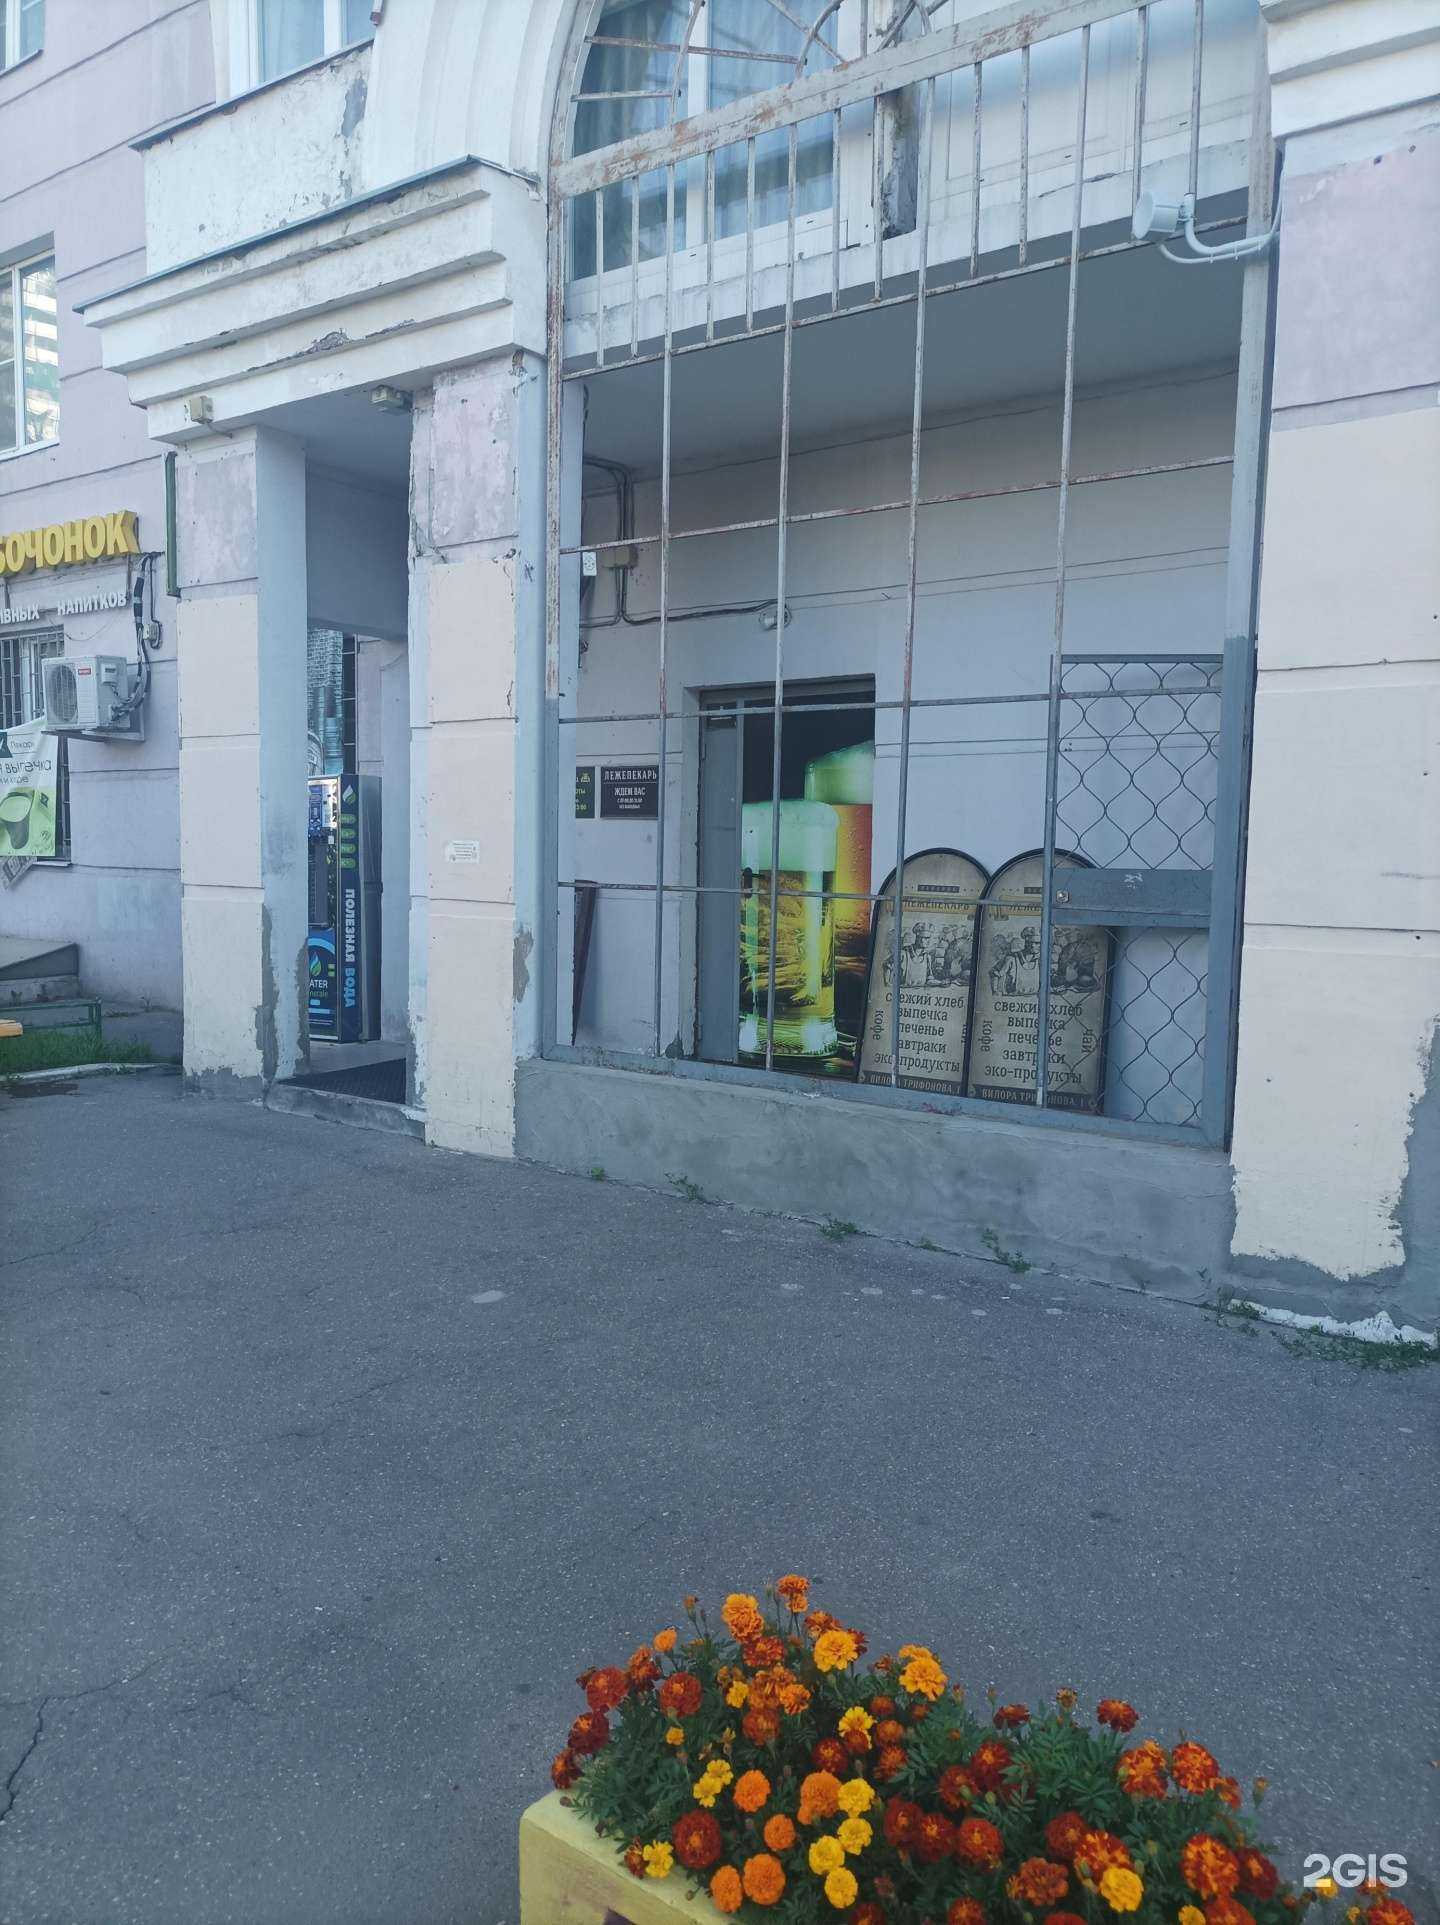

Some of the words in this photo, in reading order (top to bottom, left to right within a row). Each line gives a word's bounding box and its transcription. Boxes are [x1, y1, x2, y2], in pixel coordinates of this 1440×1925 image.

[57, 591, 127, 616] НАПИТКОВ
[604, 770, 657, 780] ЛЕЖЕПЕКАРЬ
[345, 889, 355, 962] ПОЛЕЗНАЯ
[310, 979, 328, 989] ATER
[344, 967, 355, 1008] ВОДА
[886, 993, 932, 1005] сежий
[935, 996, 964, 1008] хлеб
[993, 1001, 1038, 1013] свежи
[1048, 1003, 1083, 1016] хлеб
[870, 1010, 884, 1040] кофе
[1007, 1017, 1066, 1030] выпека
[979, 1020, 993, 1052] кофе
[1008, 1032, 1063, 1046] печеье
[898, 1040, 946, 1054] автраки
[874, 1053, 961, 1073] экопродукты
[1003, 1050, 1066, 1066] завтрки
[985, 1065, 1082, 1084] эко-проукты
